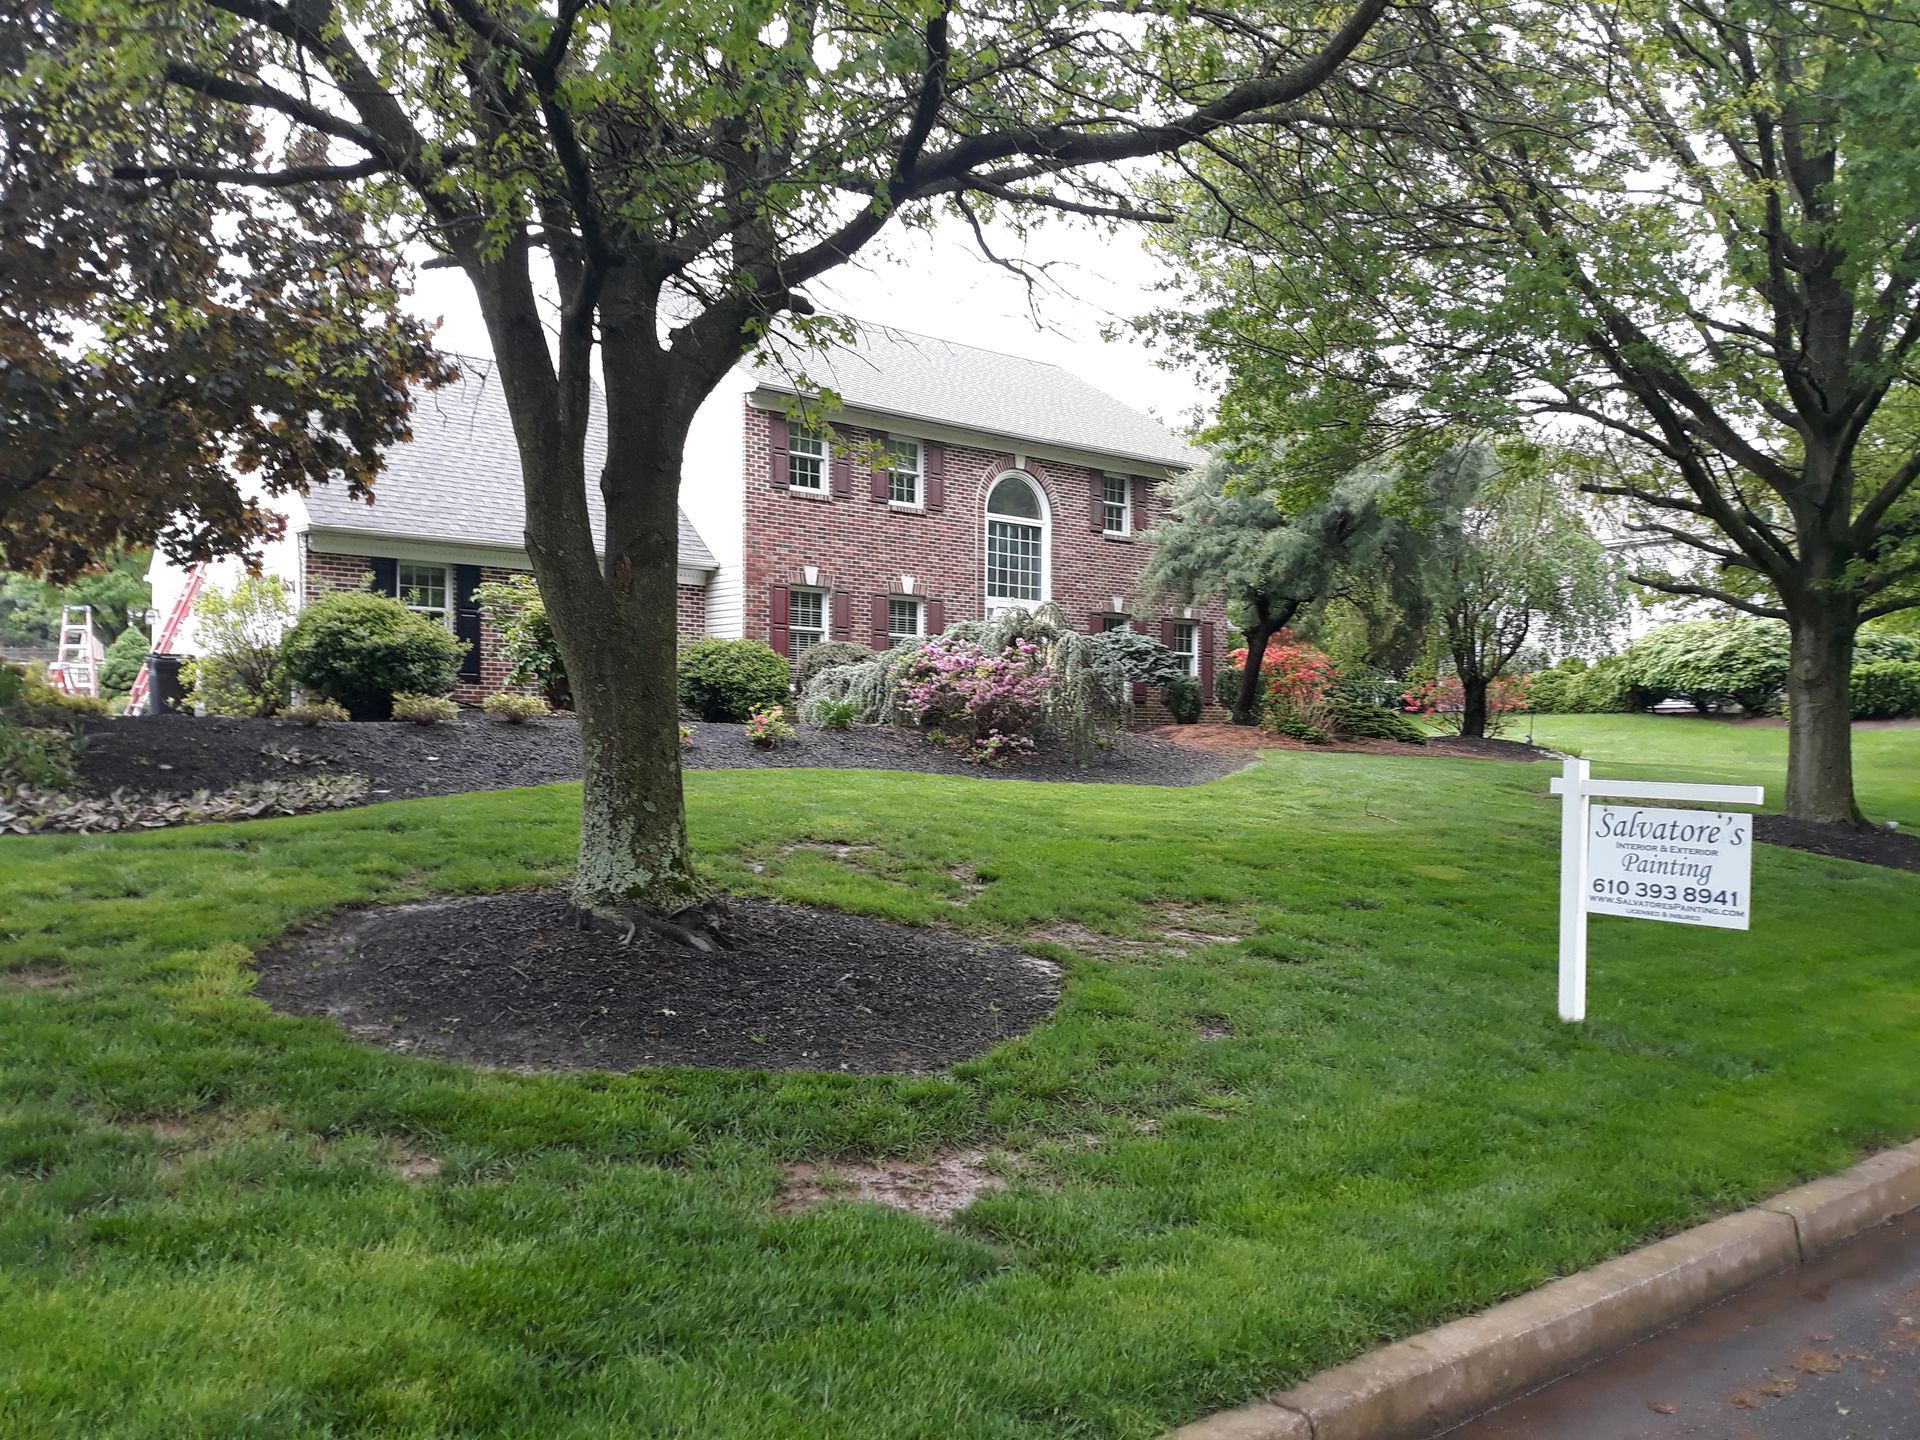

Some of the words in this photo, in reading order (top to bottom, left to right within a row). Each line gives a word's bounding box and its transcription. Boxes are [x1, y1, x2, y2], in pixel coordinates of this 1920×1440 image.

[1595, 811, 1745, 846] Salvatore's
[1660, 845, 1668, 853] &
[1621, 852, 1712, 886] Painting
[1593, 878, 1630, 895] 610
[1635, 882, 1677, 901] 393
[1683, 887, 1738, 907] 8941
